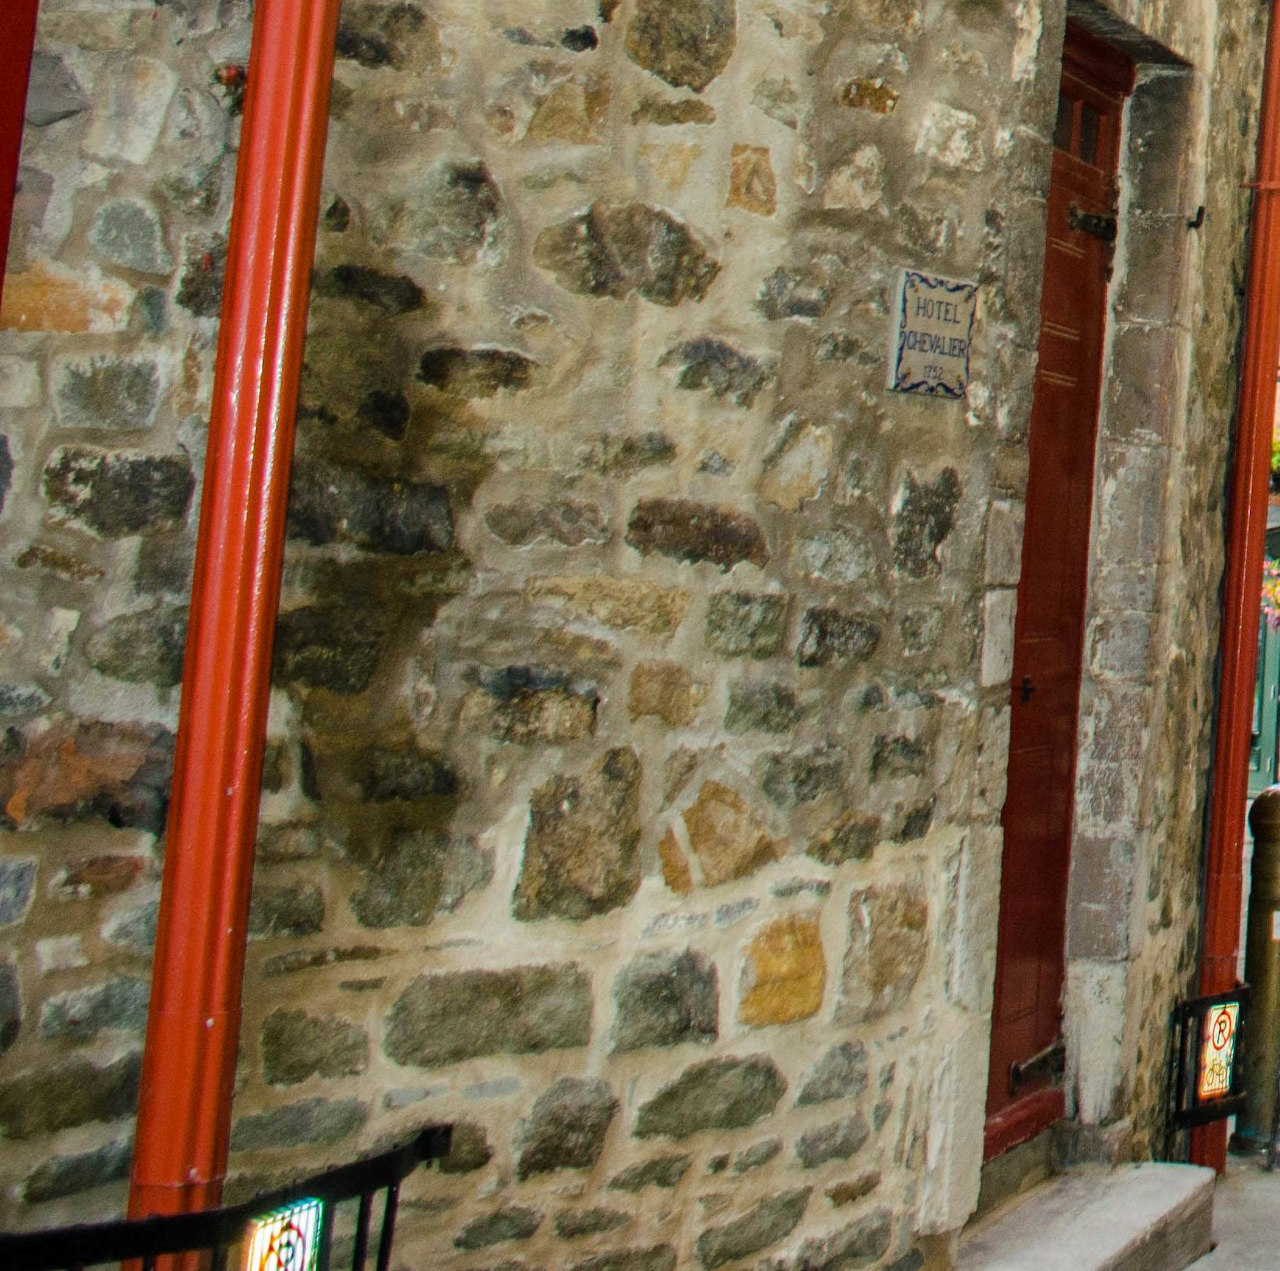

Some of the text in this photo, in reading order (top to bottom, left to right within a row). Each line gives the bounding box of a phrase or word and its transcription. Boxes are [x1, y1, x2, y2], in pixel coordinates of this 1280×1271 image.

[915, 297, 961, 324] HOTEL
[906, 330, 967, 358] CHEVALIER
[923, 365, 944, 380] 1752
